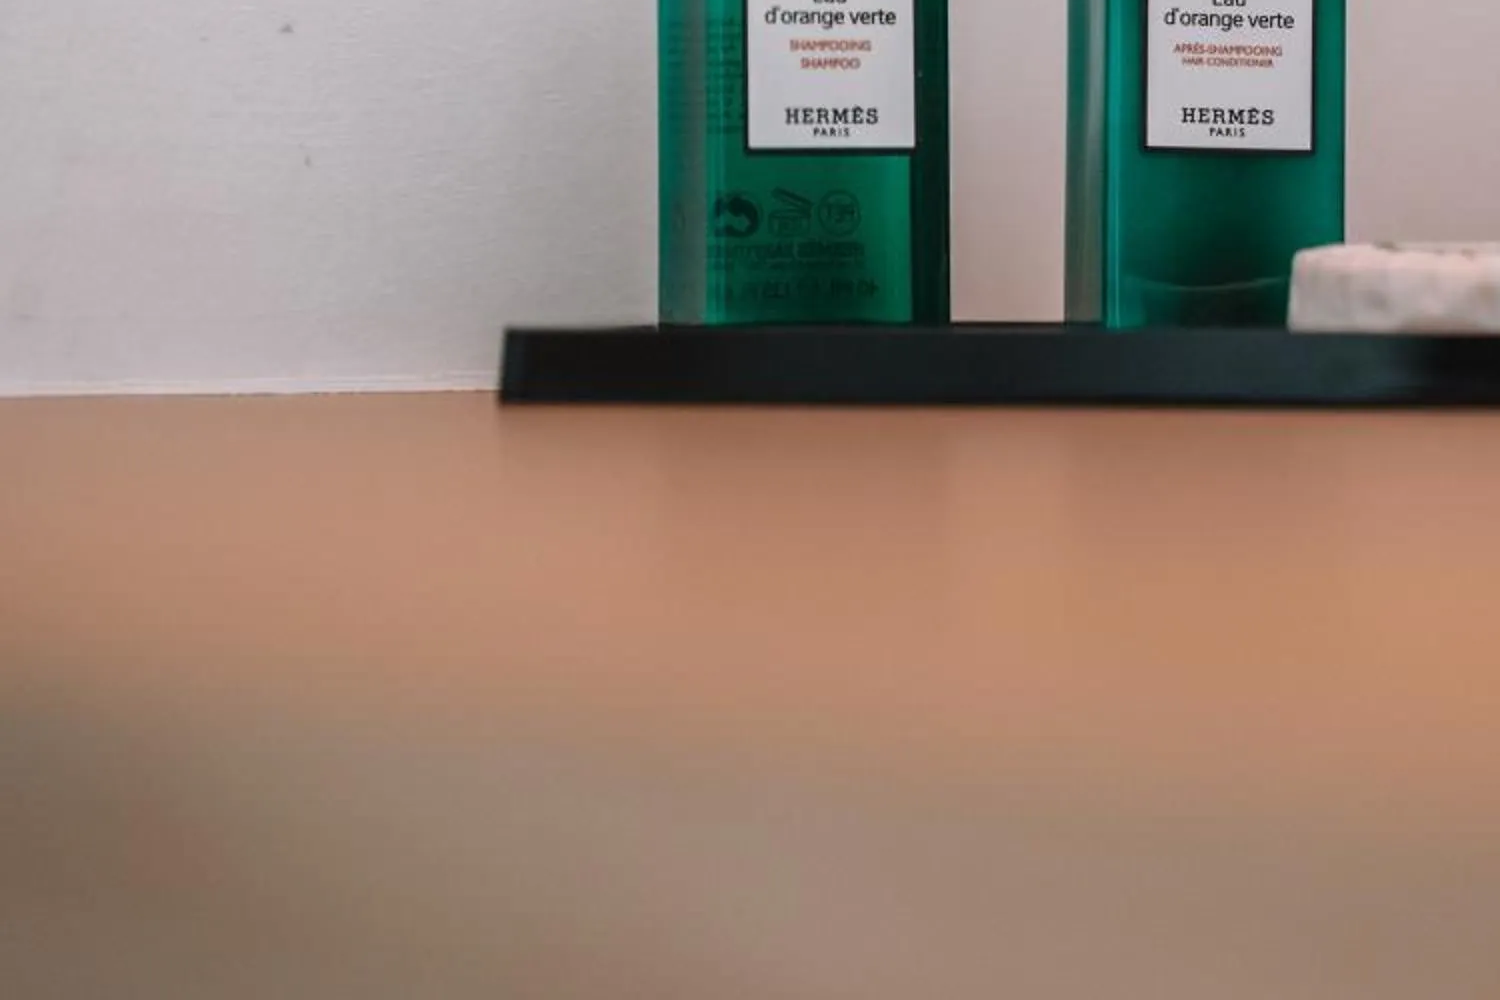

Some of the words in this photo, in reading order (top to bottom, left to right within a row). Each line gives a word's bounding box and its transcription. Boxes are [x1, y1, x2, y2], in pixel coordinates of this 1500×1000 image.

[764, 6, 844, 29] d'orange
[850, 9, 897, 25] verte
[1163, 8, 1244, 31] d'orange
[1248, 12, 1295, 29] verte
[789, 39, 872, 52] SHAMPOOING
[800, 58, 861, 69] SHAMPOO
[785, 105, 879, 125] HERMÈS
[1181, 107, 1275, 125] HERMÈS
[813, 128, 850, 138] PARIS
[1209, 127, 1246, 138] PARIS
